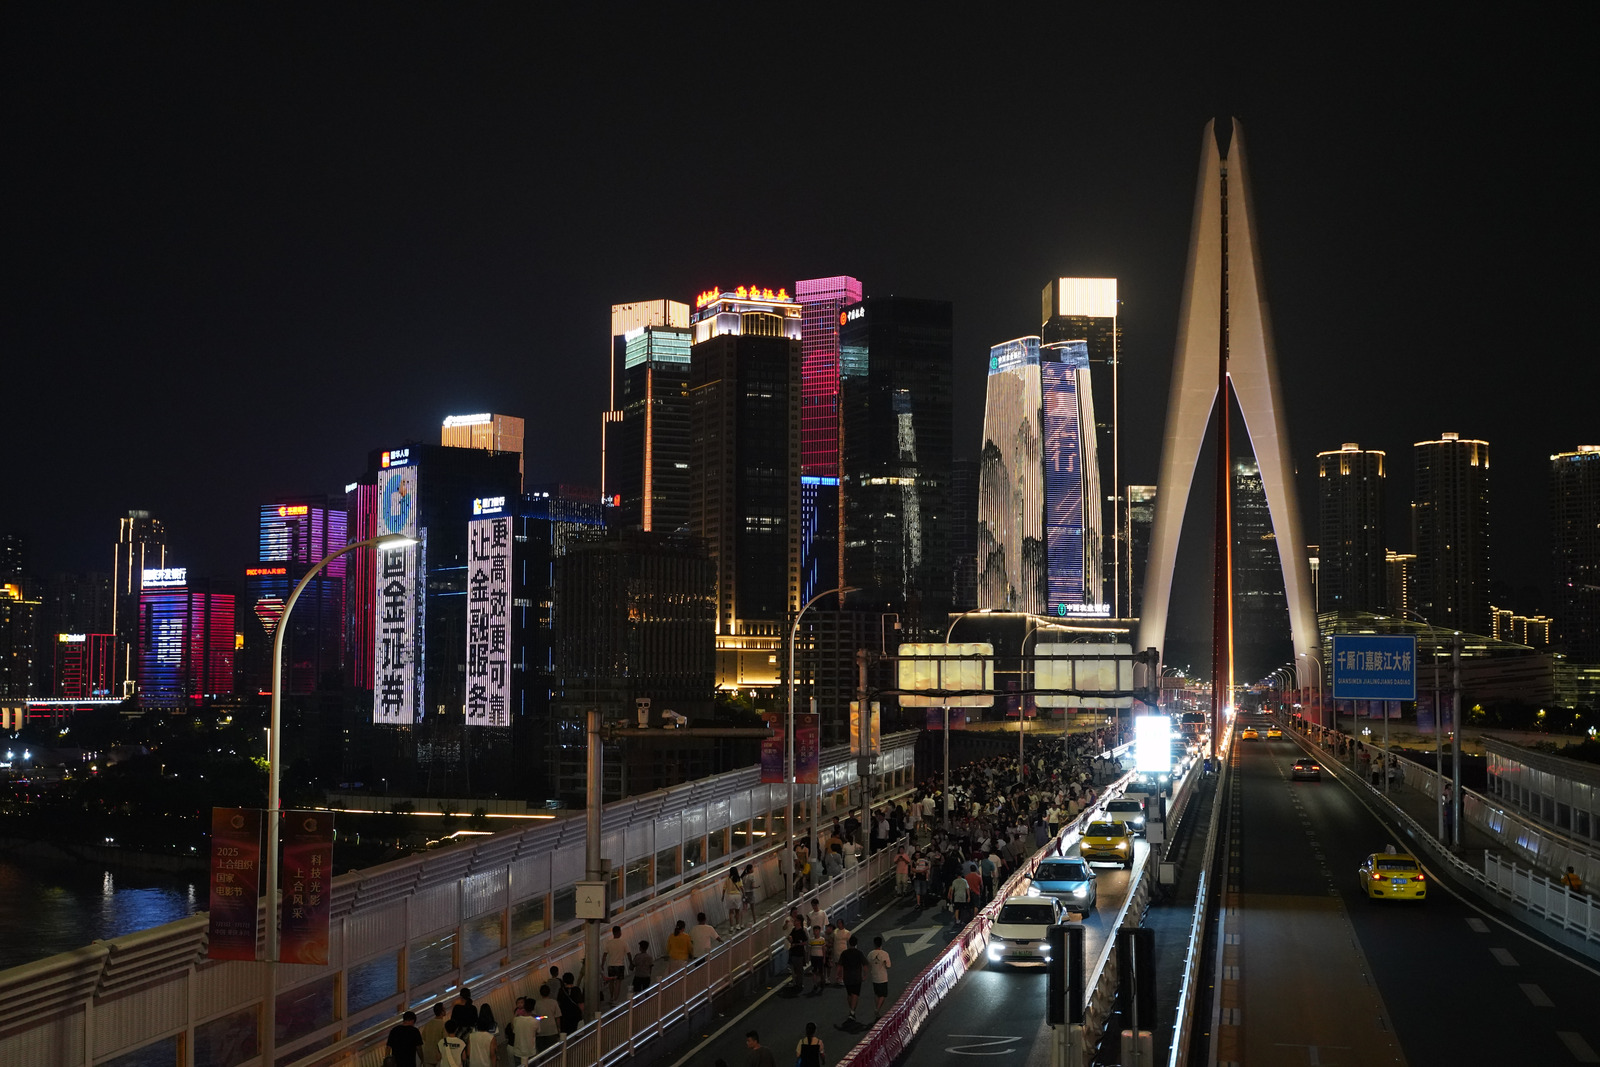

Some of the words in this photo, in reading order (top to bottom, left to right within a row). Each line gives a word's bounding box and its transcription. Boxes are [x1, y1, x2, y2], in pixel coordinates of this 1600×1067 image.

[847, 306, 865, 322] 中国银行
[381, 546, 406, 715] 国金证券
[470, 527, 490, 719] 让金融服务
[490, 519, 509, 724] 更高效更可靠
[1337, 650, 1411, 671] 千厮门嘉陵江大桥
[217, 847, 239, 857] 2025
[216, 859, 254, 871] 上合组织
[216, 873, 235, 883] 国家
[310, 854, 322, 907] 科技光影
[216, 886, 243, 897] 电影节
[292, 868, 304, 919] 上合风采
